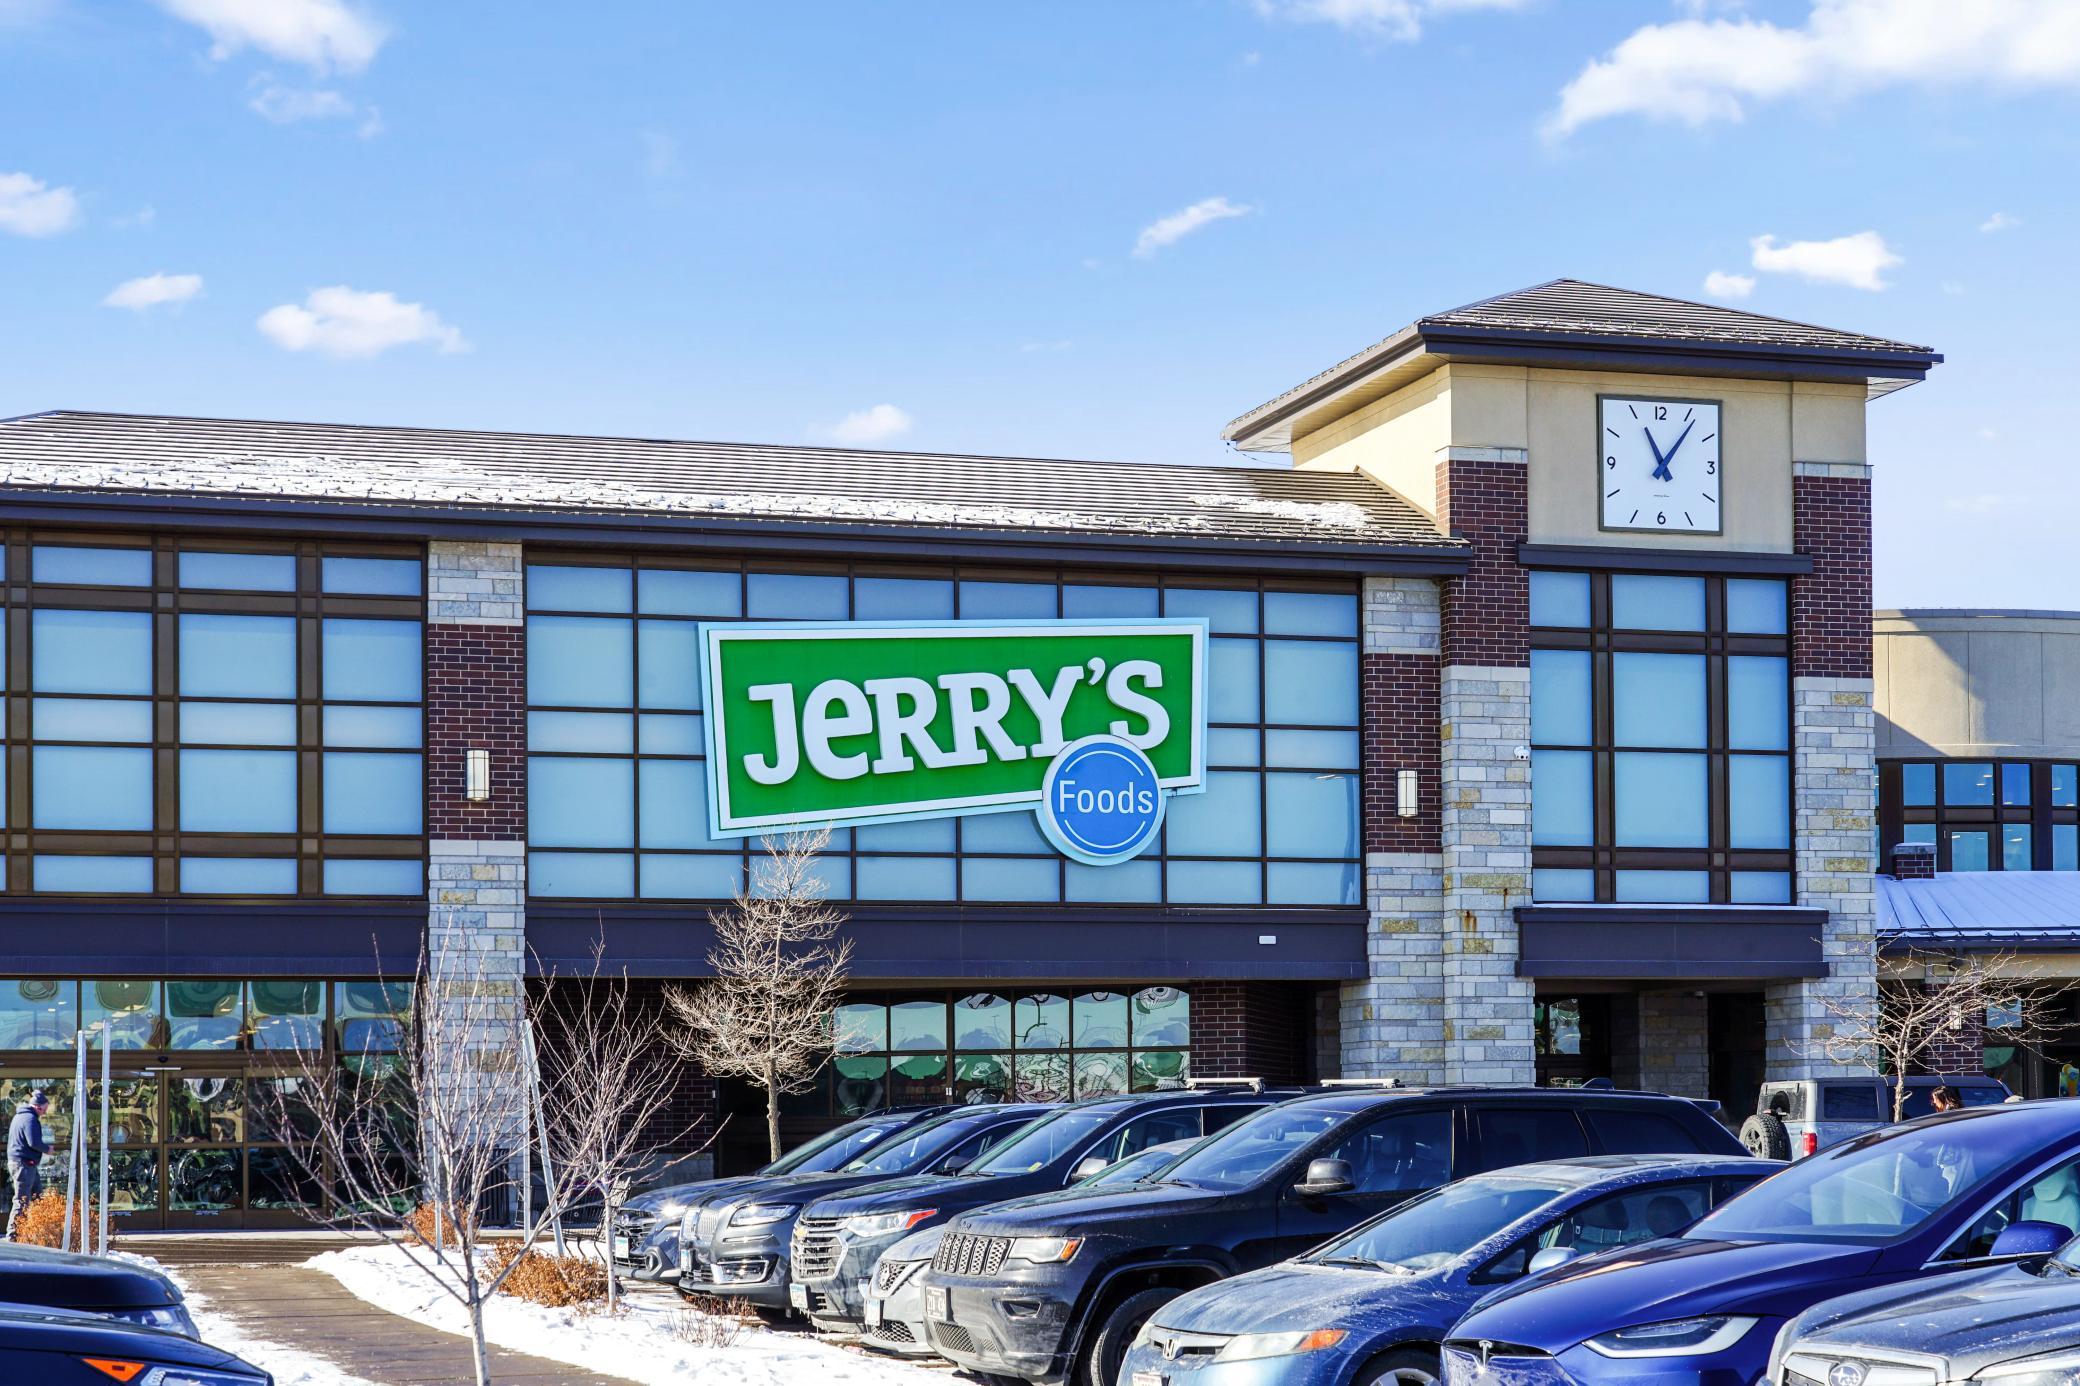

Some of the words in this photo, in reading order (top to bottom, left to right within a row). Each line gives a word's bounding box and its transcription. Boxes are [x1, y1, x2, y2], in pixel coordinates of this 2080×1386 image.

[1654, 406, 1667, 421] 12
[1606, 456, 1616, 470] 9
[1706, 460, 1716, 475] 3
[1656, 511, 1667, 525] 6
[1059, 780, 1153, 814] Foods
